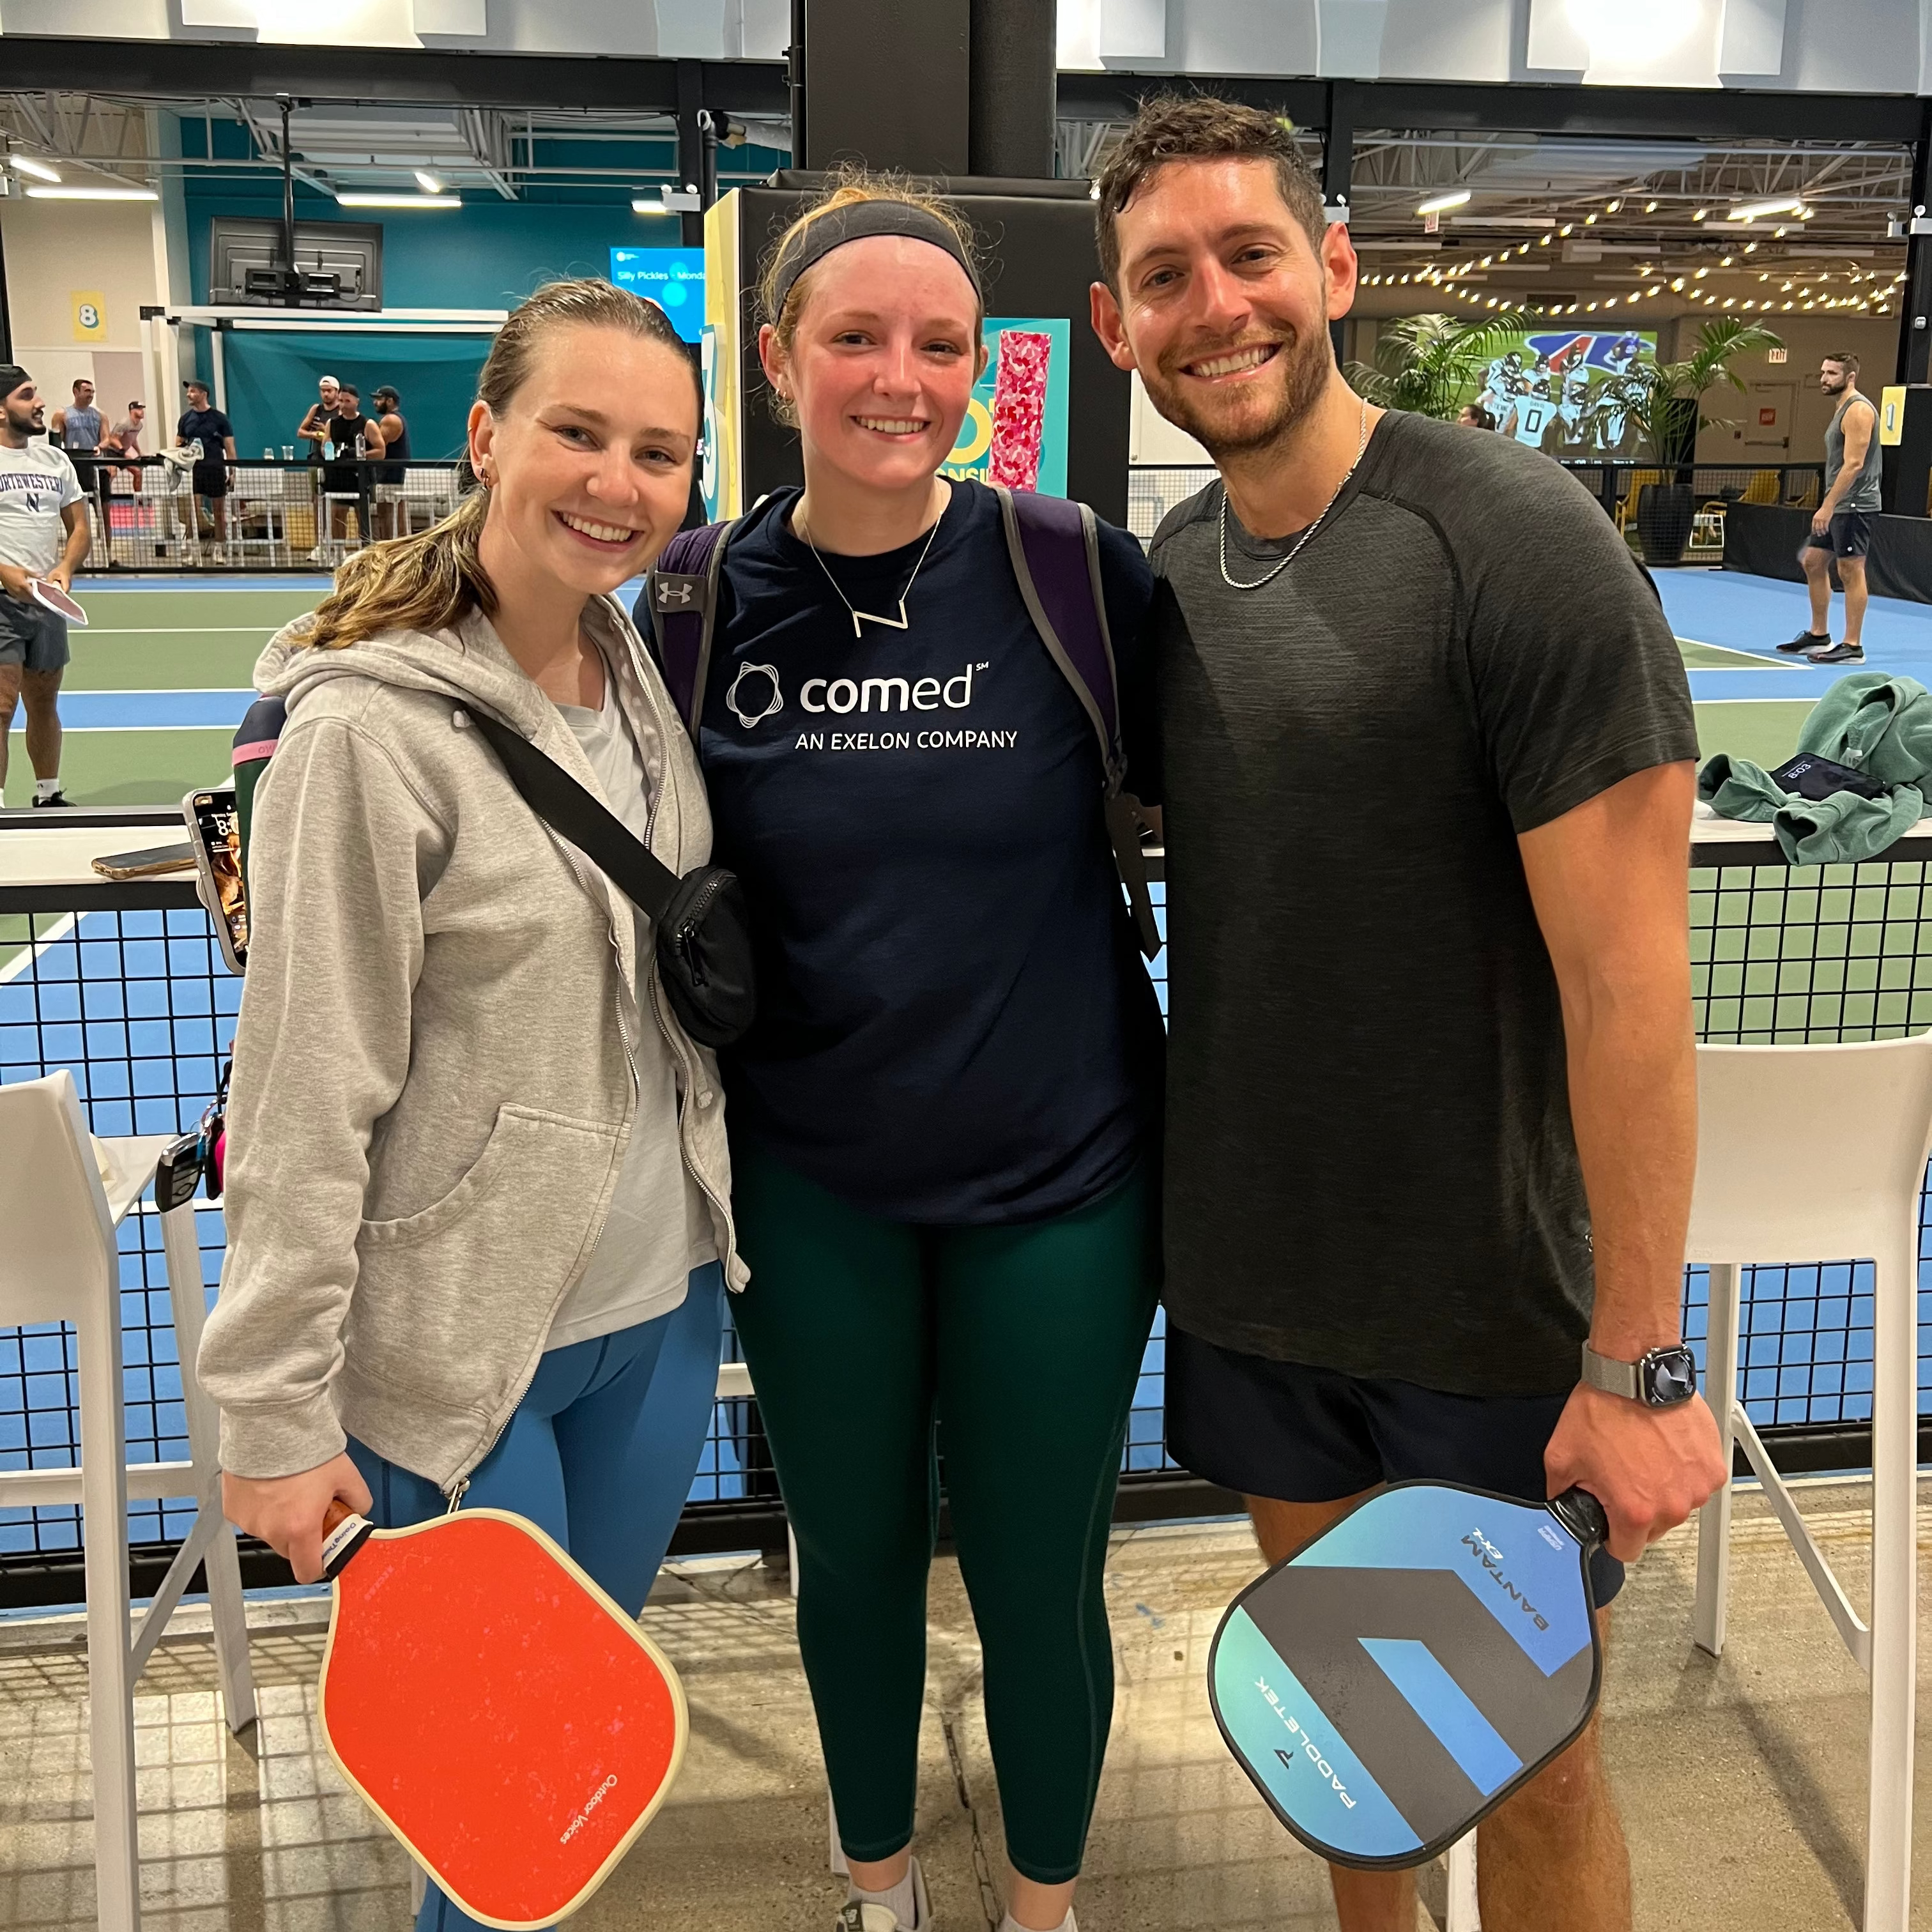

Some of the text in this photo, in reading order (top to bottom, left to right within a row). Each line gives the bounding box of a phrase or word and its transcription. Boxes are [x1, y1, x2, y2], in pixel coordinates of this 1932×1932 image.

[617, 271, 636, 281] Silly
[637, 271, 669, 280] Pickles
[677, 272, 705, 280] Monda
[79, 303, 99, 328] 8
[1524, 409, 1542, 433] 0
[1886, 403, 1894, 431] 1
[26, 493, 40, 513] N
[800, 661, 990, 714] comed SM
[795, 730, 1018, 750] AN EXELON COMPANY
[1788, 763, 1811, 778] 8:03
[1460, 1535, 1550, 1631] BANTAM
[1254, 1675, 1357, 1809] PADDLETEK
[560, 1774, 618, 1844] Outdoor Voices
